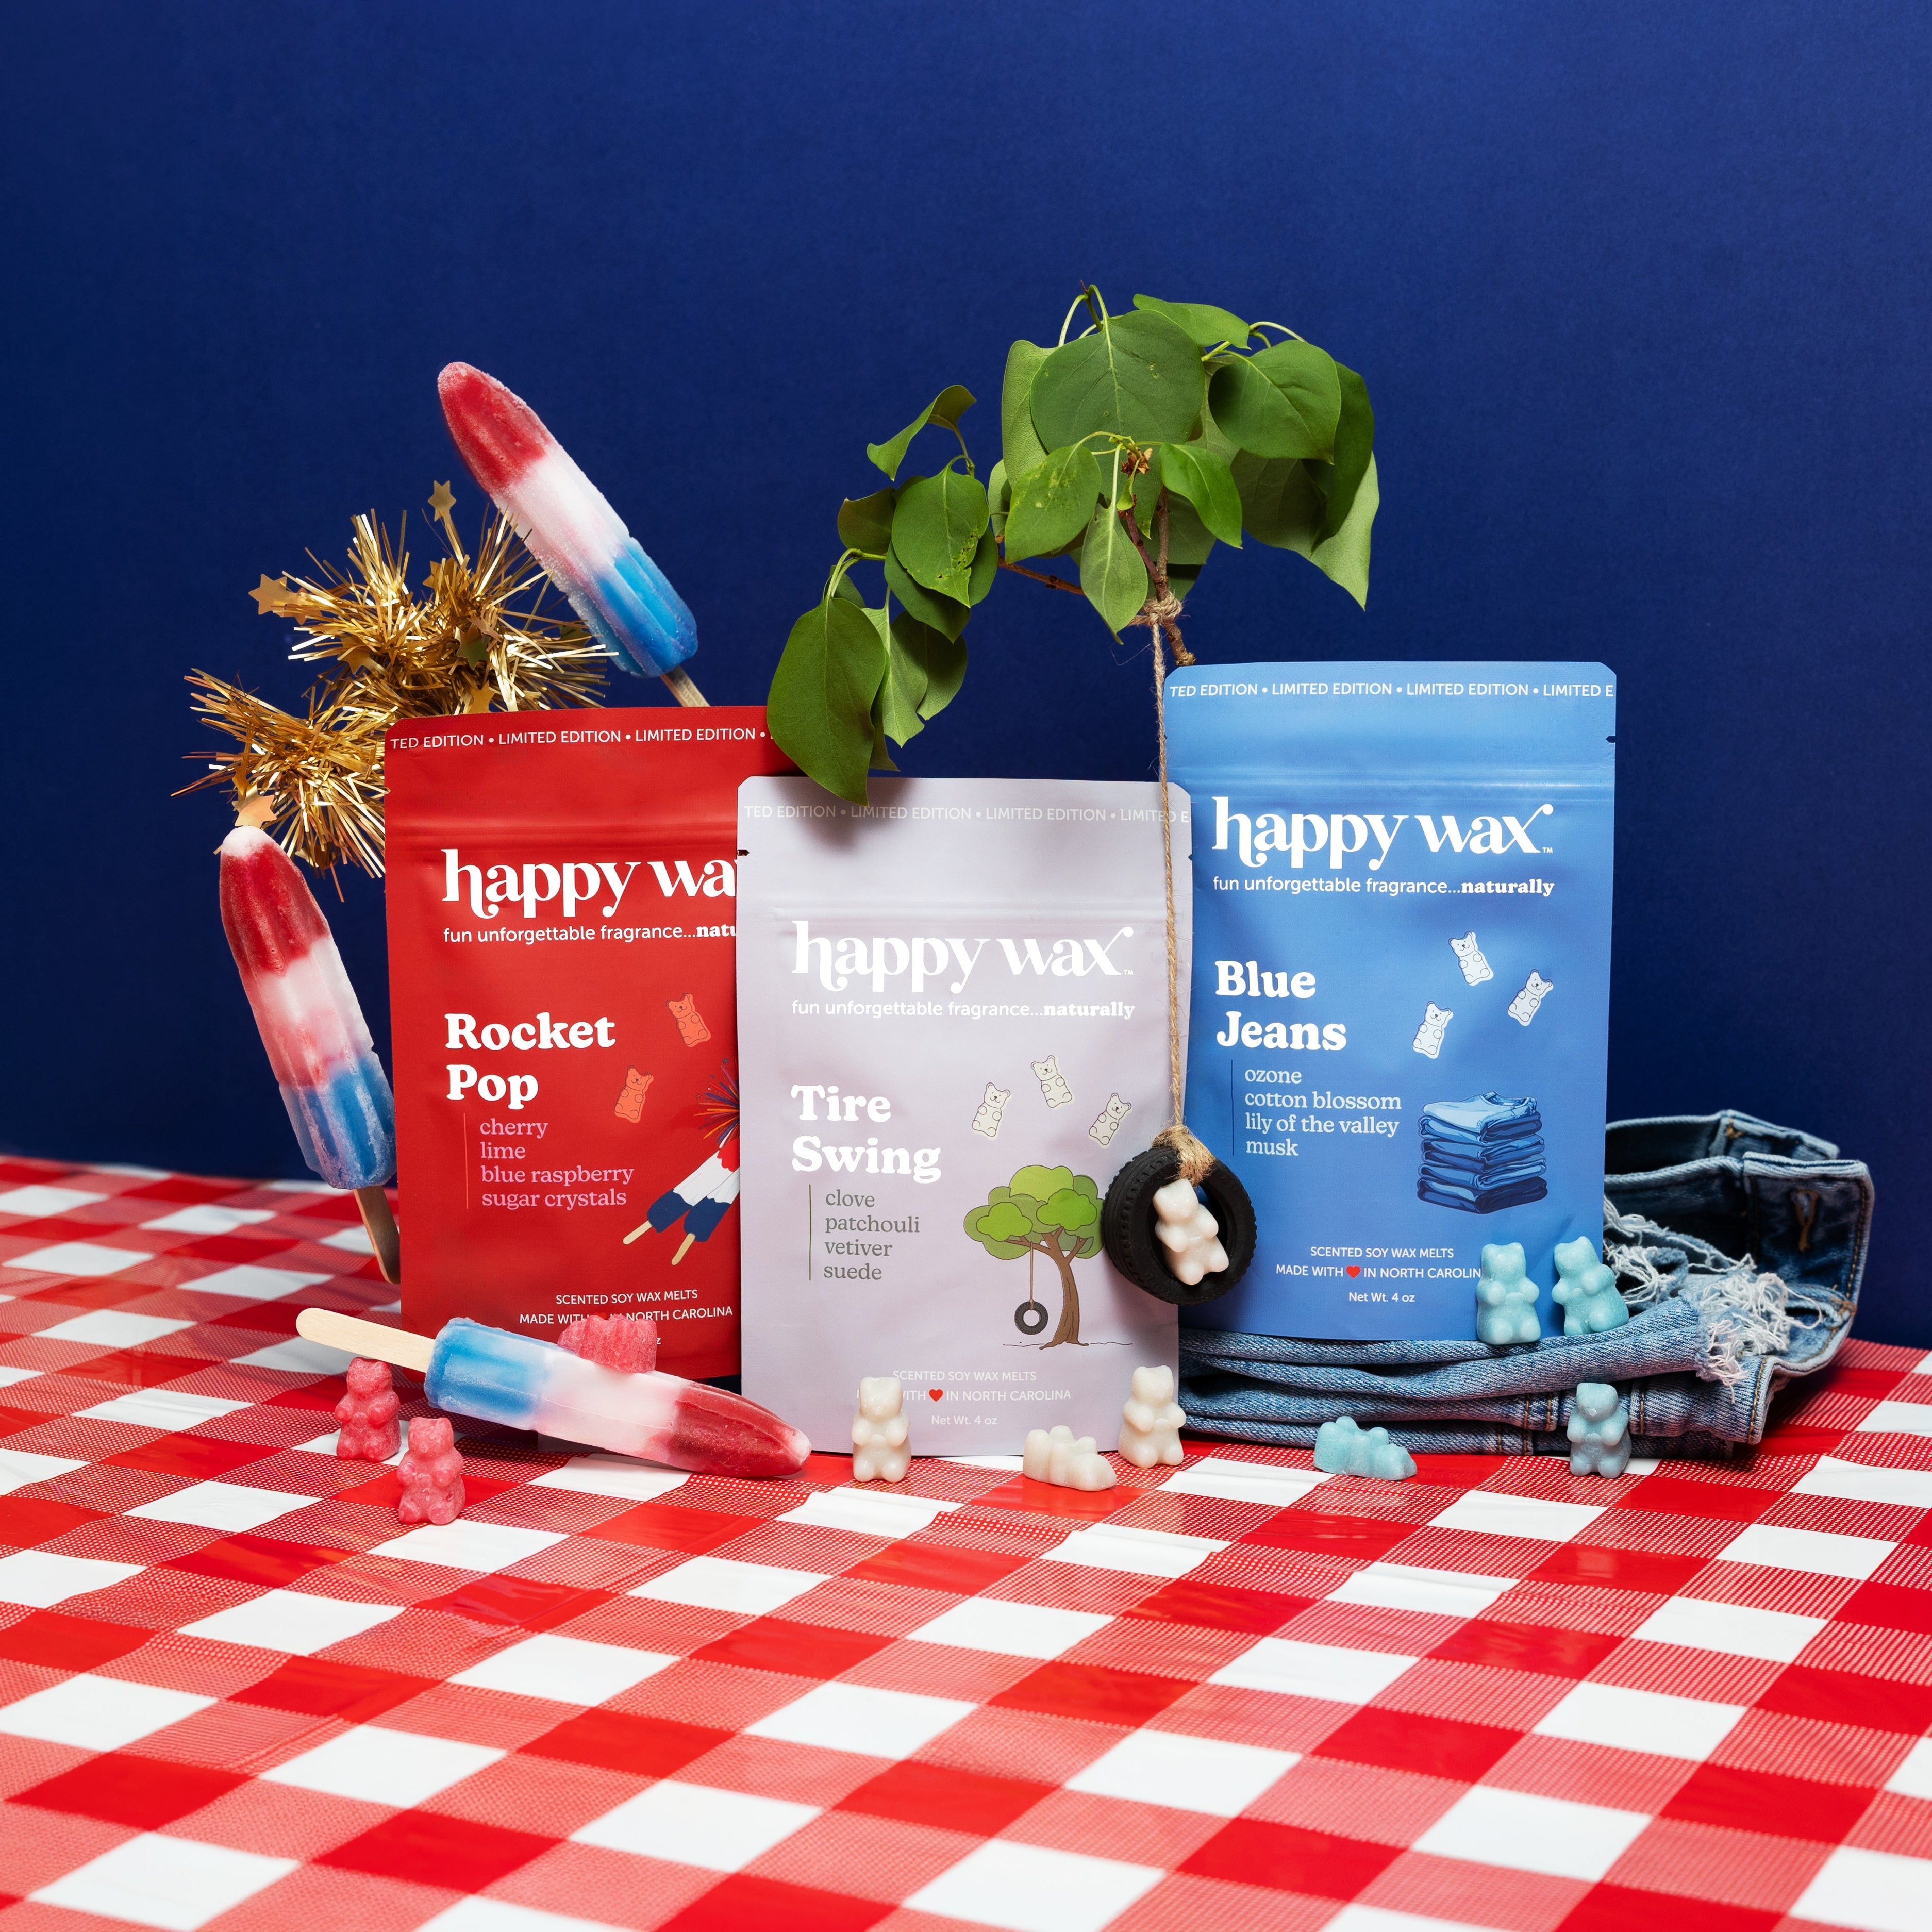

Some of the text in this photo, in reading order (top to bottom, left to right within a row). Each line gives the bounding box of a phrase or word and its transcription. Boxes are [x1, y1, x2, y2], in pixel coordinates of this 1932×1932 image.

[1201, 684, 1257, 695] EDITION
[1272, 683, 1328, 694] LIMITED
[1333, 683, 1392, 694] EDITION
[1407, 683, 1464, 695] LIMITED
[1469, 684, 1528, 695] EDITION
[1543, 685, 1601, 696] LIMITED
[424, 735, 483, 747] EDITION
[499, 732, 556, 744] LIMITED
[561, 730, 620, 742] EDITION
[636, 729, 692, 741] LIMITED
[697, 728, 755, 740] EDITION
[778, 806, 835, 817] EDITION
[851, 806, 907, 819] LIMITED
[912, 807, 971, 819] EDITION
[987, 808, 1042, 819] LIMITED
[1047, 808, 1105, 821] EDITION
[1120, 808, 1176, 822] LIMITED
[1212, 797, 1409, 871] happy
[441, 849, 737, 919] happy wa
[1213, 876, 1239, 890] fun
[1245, 876, 1361, 894] unforgettable
[444, 928, 472, 942] fun
[478, 926, 595, 945] unforgettable
[792, 921, 990, 994] happy
[1215, 961, 1315, 998] Blue
[792, 1000, 819, 1014] fun
[826, 1001, 942, 1019] unforgettable
[445, 1012, 615, 1050] Rocket
[1217, 1011, 1346, 1050] Jeans
[1245, 1070, 1302, 1084] ozone
[446, 1064, 538, 1109] Pop
[791, 1085, 891, 1122] Tire
[1245, 1091, 1402, 1109] cotton blossom
[480, 1118, 548, 1139] cherry
[1245, 1112, 1400, 1137] lily of the valley
[480, 1142, 525, 1159] lime
[1246, 1138, 1299, 1156] musk
[792, 1135, 941, 1184] Swing
[481, 1165, 634, 1186] blue raspberry
[482, 1188, 626, 1210] sugar crystals
[826, 1189, 874, 1207] clove
[825, 1215, 920, 1233] patchouli
[825, 1239, 892, 1256] vetiver
[1311, 1246, 1454, 1258] SCENTED SOY WAX MELTS
[824, 1263, 881, 1280] suede
[1276, 1265, 1481, 1278] MADE WITH IN NORTH CAROLIN
[556, 1290, 697, 1304] SCENTED SOY WAX MELTS
[1349, 1292, 1368, 1302] Net
[1371, 1293, 1388, 1302] Wt.
[1392, 1293, 1398, 1302] 4
[520, 1314, 554, 1324] MADE
[673, 1306, 732, 1320] CAROLINA
[893, 1370, 1036, 1380] SCENTED SOY WAX MELTS
[947, 1391, 958, 1401] IN
[963, 1391, 1006, 1401] NORTH
[1010, 1390, 1071, 1401] CAROLINA
[932, 1415, 951, 1425] Net
[954, 1415, 971, 1425] Wt.
[974, 1415, 981, 1424] 4
